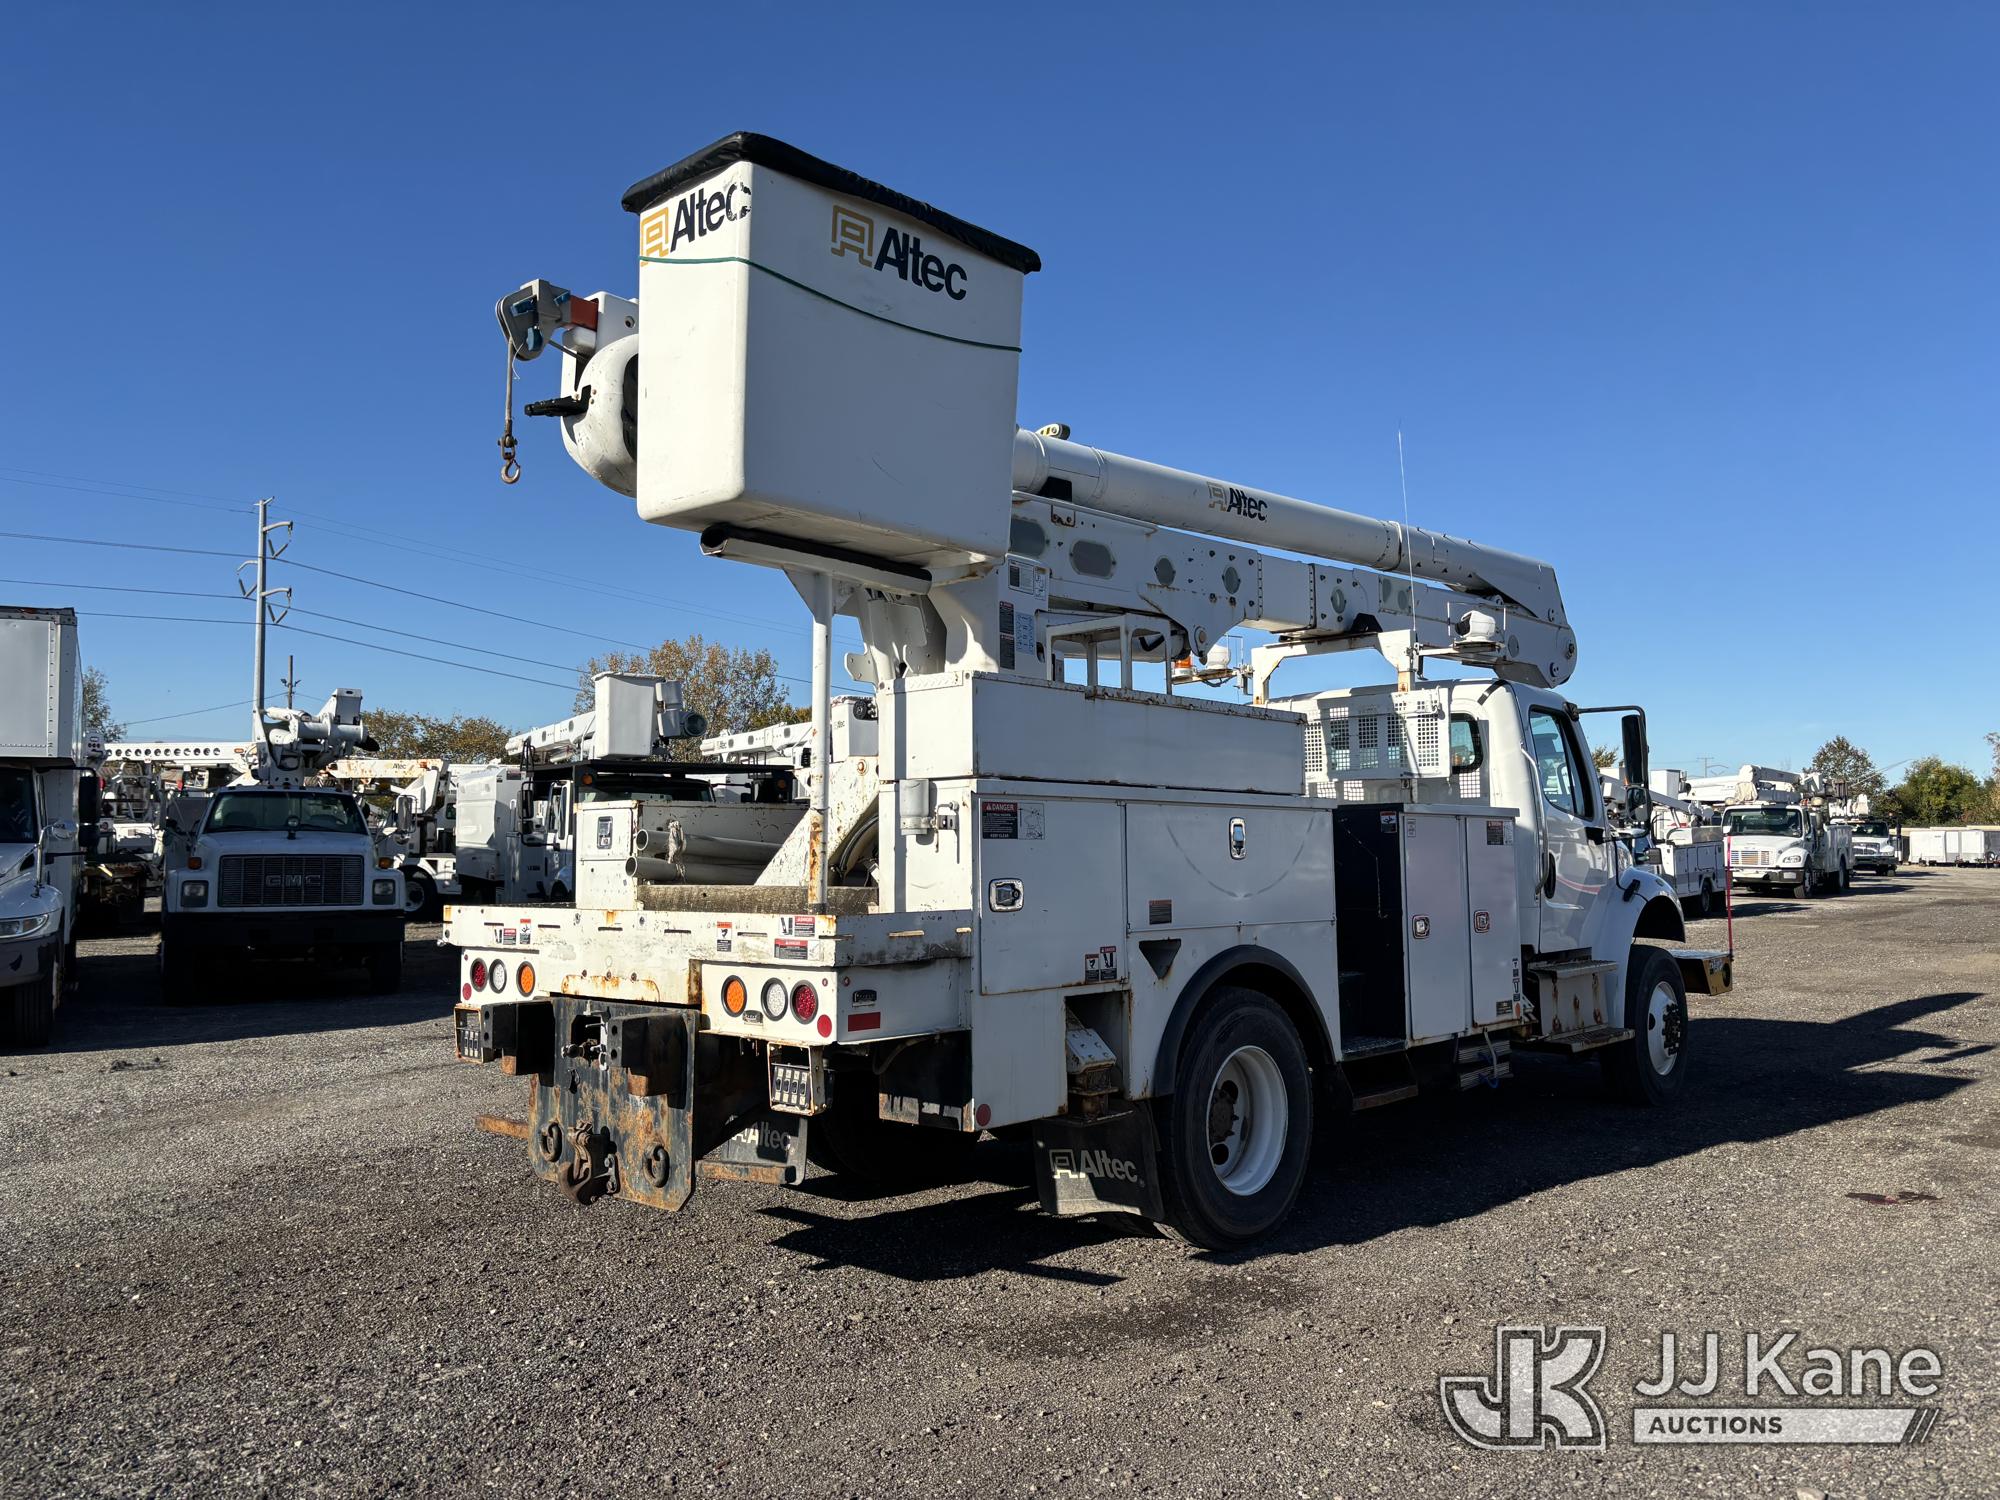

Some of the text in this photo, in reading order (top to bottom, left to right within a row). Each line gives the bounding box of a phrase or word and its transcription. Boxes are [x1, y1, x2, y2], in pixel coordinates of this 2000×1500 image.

[670, 183, 751, 253] Altec
[874, 226, 967, 301] Altec
[1227, 487, 1268, 521] Altec
[992, 803, 1014, 811] DANGER
[265, 874, 321, 888] GMC
[747, 1120, 791, 1149] Altec
[1080, 1149, 1137, 1183] Altec
